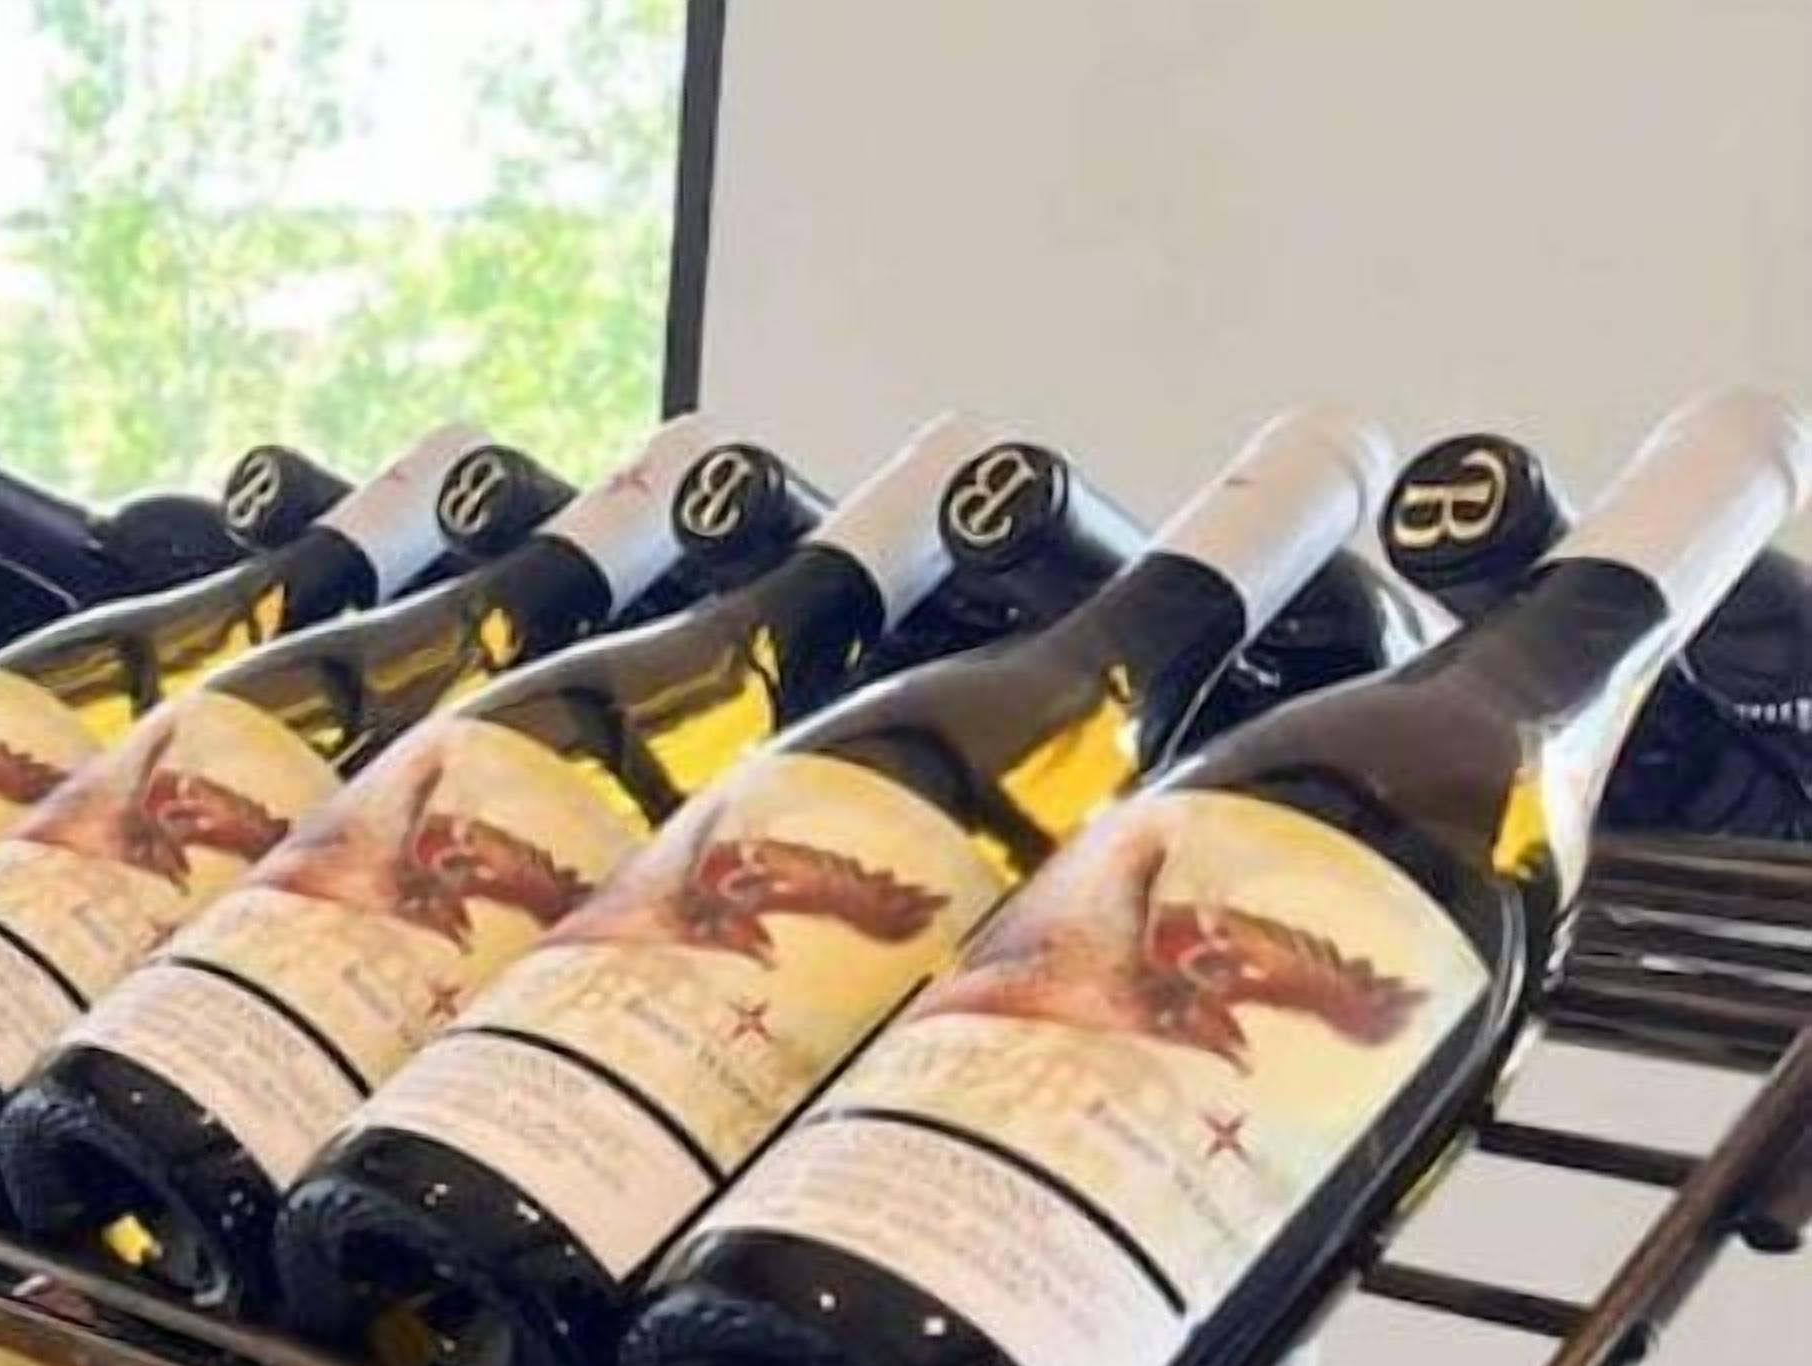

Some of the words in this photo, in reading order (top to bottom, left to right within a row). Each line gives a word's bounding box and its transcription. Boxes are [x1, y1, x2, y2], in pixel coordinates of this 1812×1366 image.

[681, 452, 750, 536] B
[946, 447, 1036, 548] B
[1392, 449, 1510, 550] B
